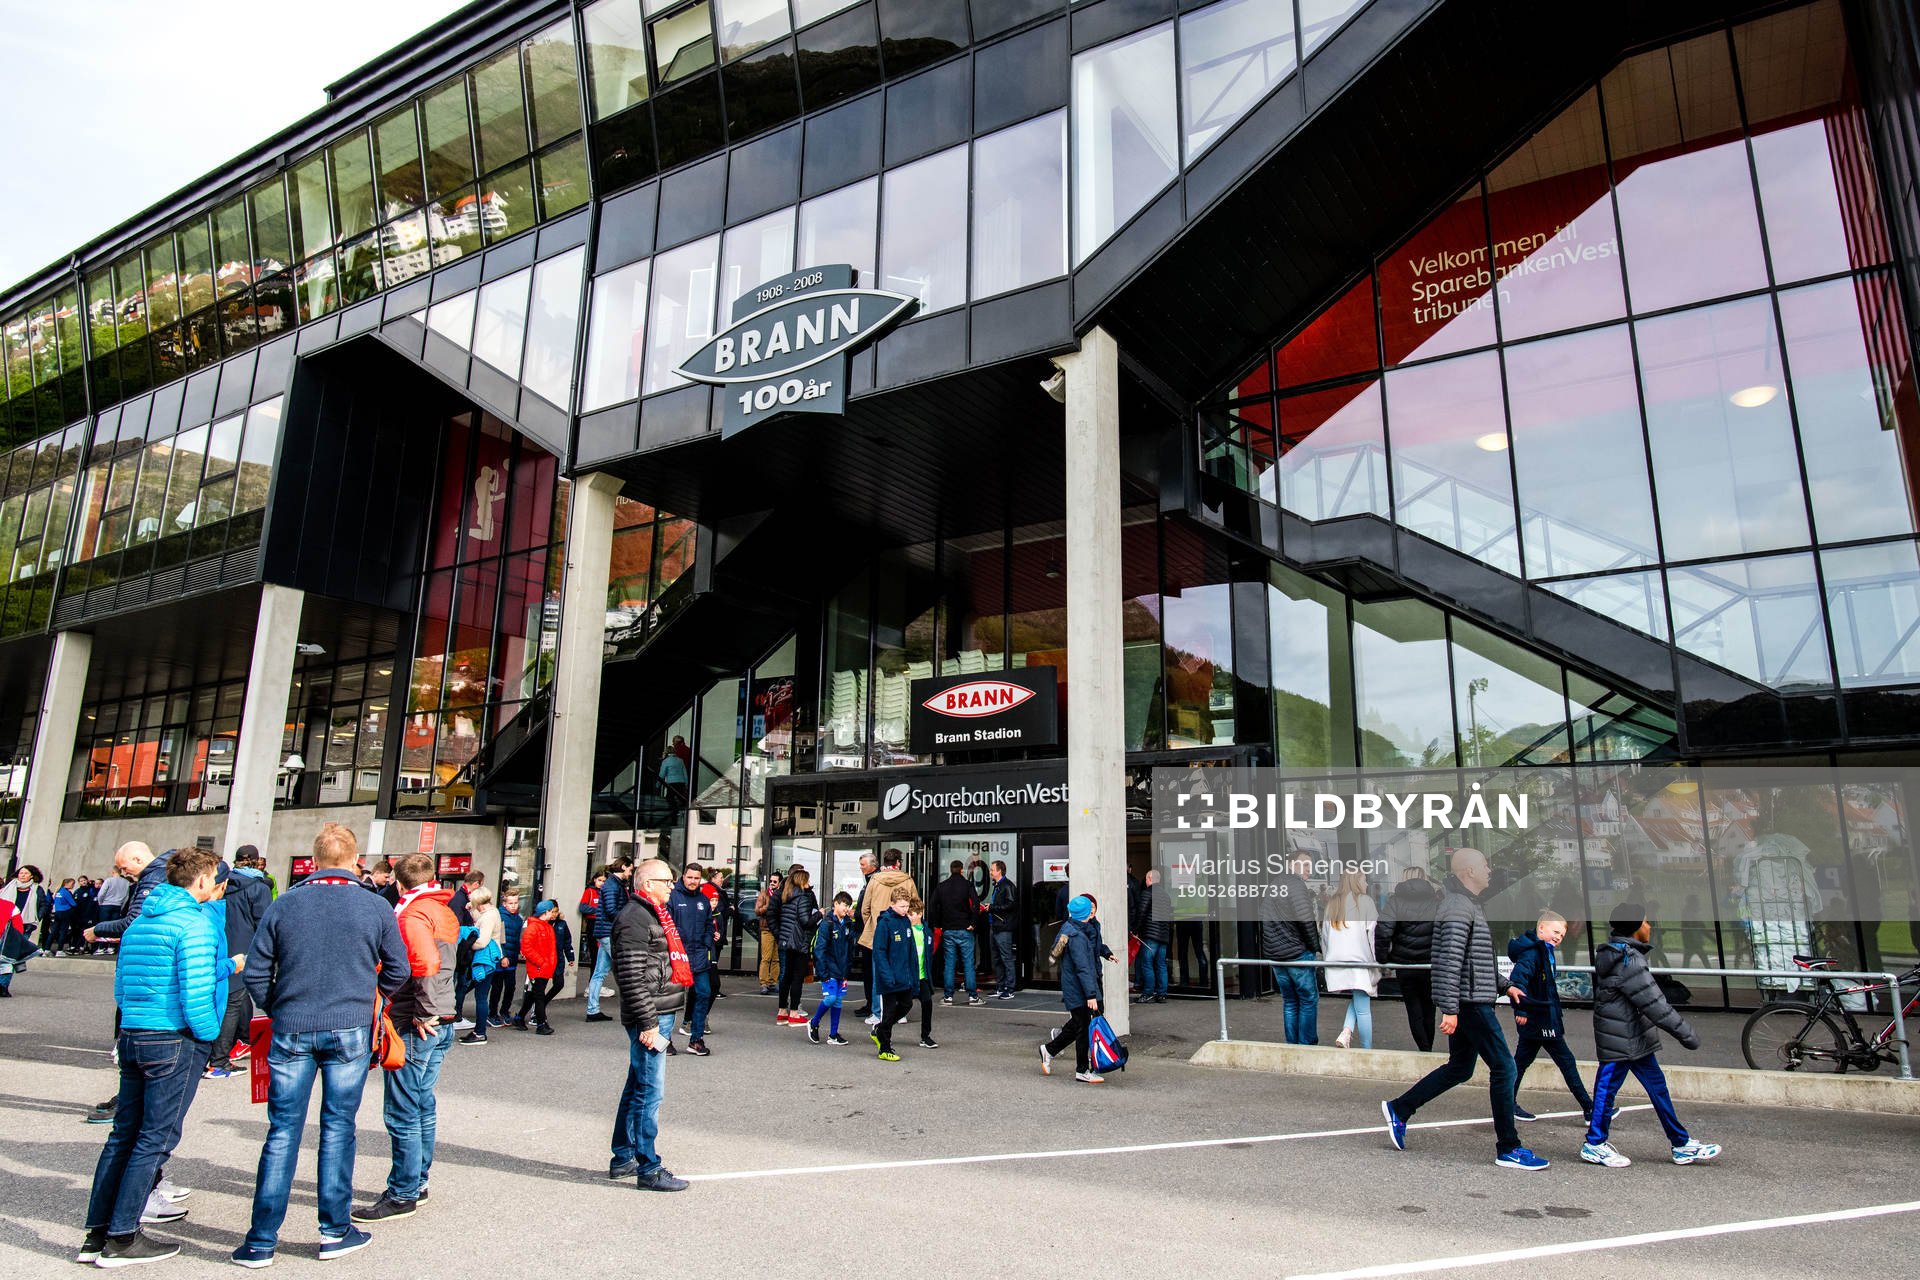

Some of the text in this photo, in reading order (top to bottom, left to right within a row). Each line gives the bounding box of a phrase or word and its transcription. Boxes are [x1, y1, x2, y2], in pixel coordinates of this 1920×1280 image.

[1409, 221, 1578, 278] Velkommen til
[756, 284, 783, 303] 1908
[793, 272, 824, 293] 2008
[1410, 237, 1621, 304] SparebankenVest
[1413, 289, 1512, 325] tribunen
[714, 297, 861, 374] BRANN
[738, 378, 833, 416] 100år
[946, 687, 1014, 710] BRANN
[935, 728, 1022, 744] Brann Stadion
[911, 782, 1069, 814] SparebankenVest
[946, 810, 1001, 824] Tribunen
